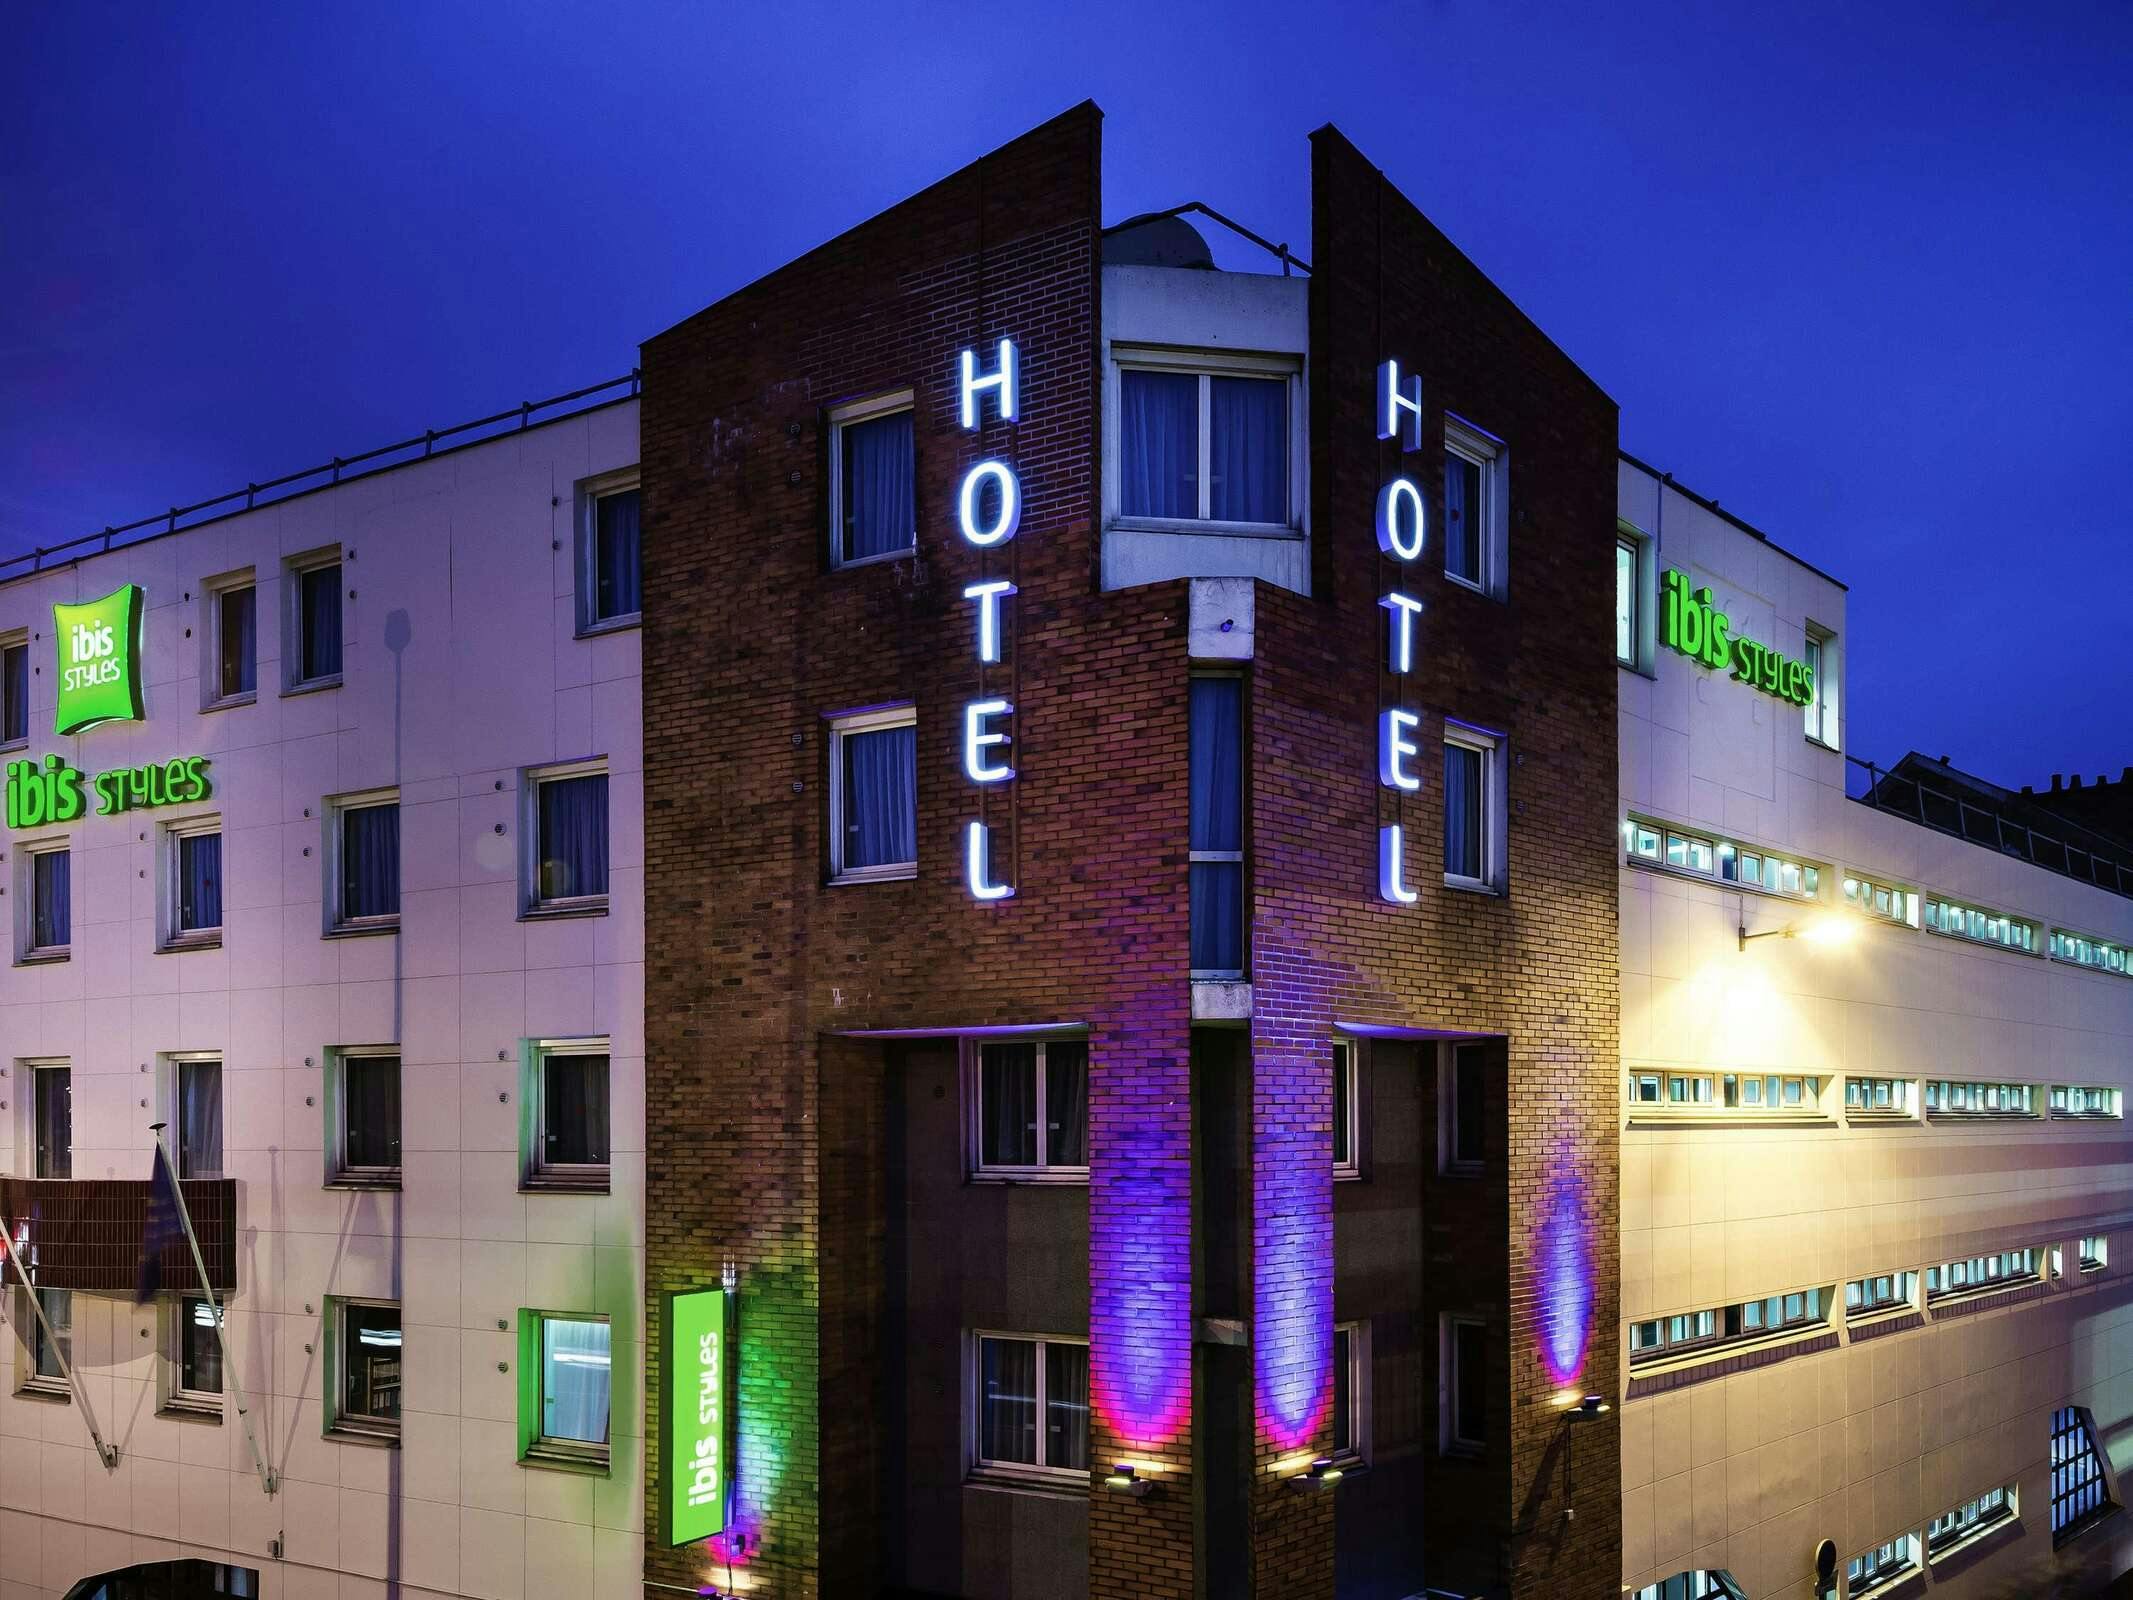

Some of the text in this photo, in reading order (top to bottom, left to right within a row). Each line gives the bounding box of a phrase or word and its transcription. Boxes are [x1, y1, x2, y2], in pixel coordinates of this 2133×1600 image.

[71, 619, 114, 664] ibis
[959, 338, 1019, 900] HOTEL
[1376, 358, 1424, 904] HOTEL
[1664, 568, 1730, 670] ibis
[6, 753, 79, 829] ibis
[688, 1434, 719, 1508] ibis
